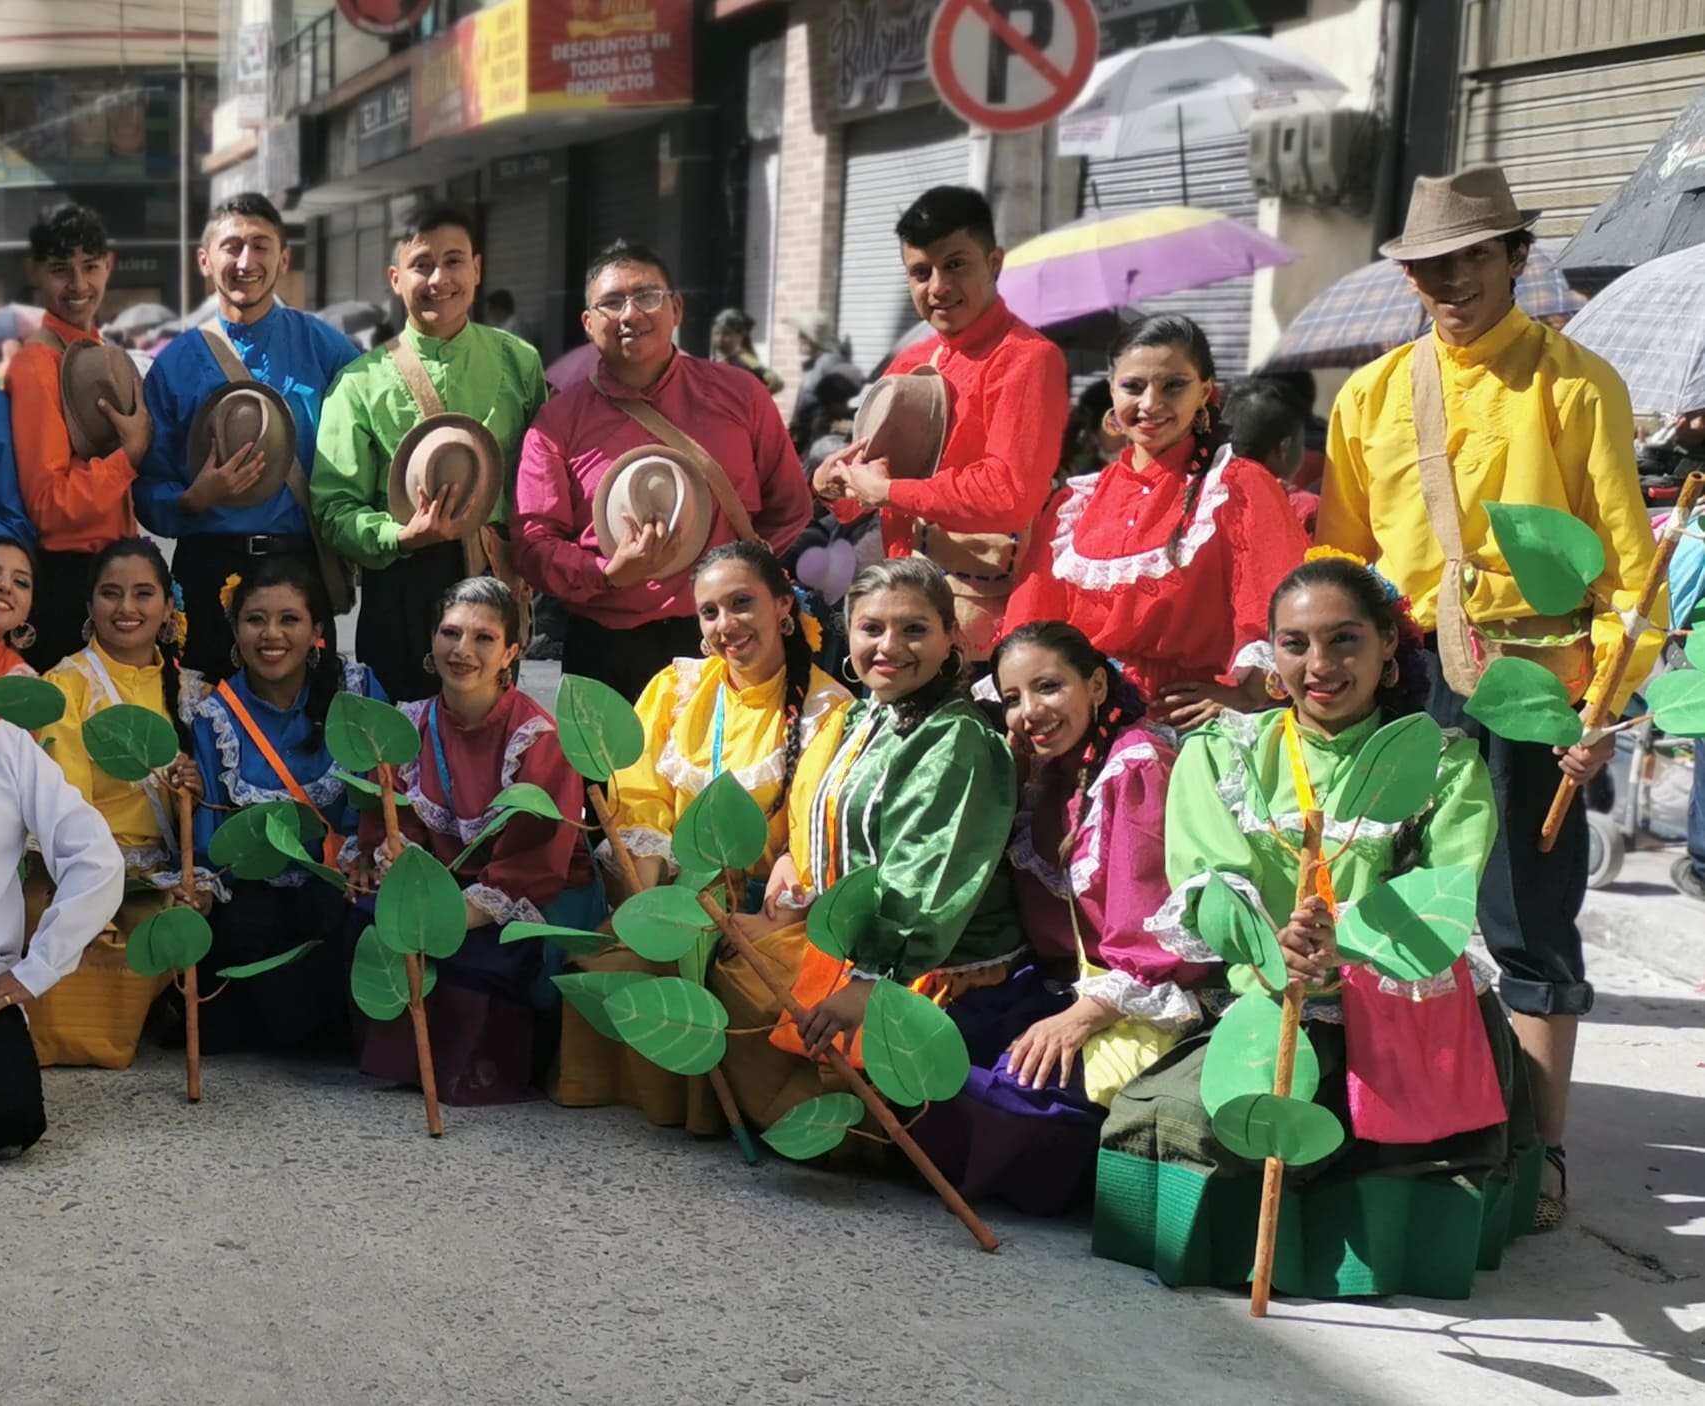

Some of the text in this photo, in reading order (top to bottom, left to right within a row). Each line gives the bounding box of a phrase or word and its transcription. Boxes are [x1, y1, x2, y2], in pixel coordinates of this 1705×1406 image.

[551, 32, 671, 61] DESCUENTOS EN
[570, 53, 653, 77] TODOS LOS
[566, 73, 655, 97] PRODUCTOS
